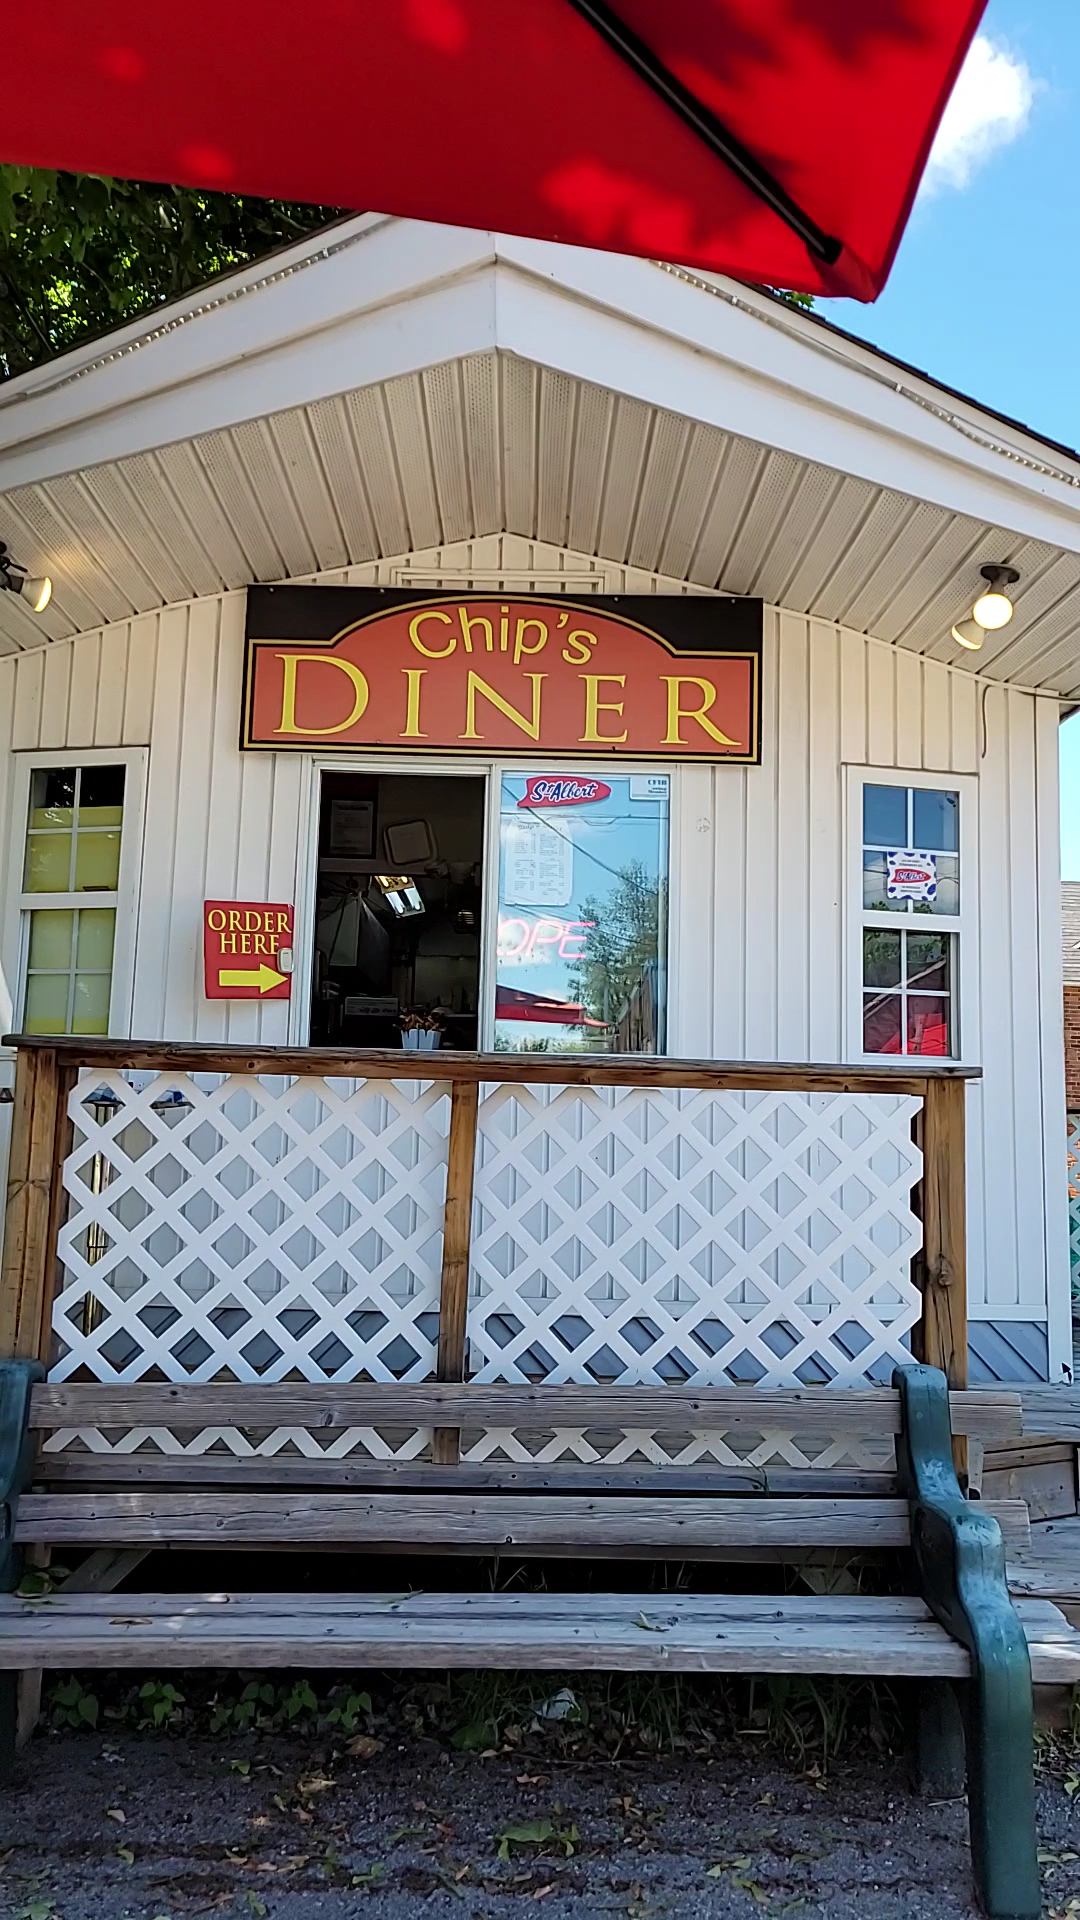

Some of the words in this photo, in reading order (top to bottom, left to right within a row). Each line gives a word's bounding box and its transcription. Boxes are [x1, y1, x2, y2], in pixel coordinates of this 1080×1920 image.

[408, 605, 598, 665] Chip's
[272, 653, 741, 746] DINER
[208, 909, 292, 933] ORDER
[219, 932, 280, 955] HERE
